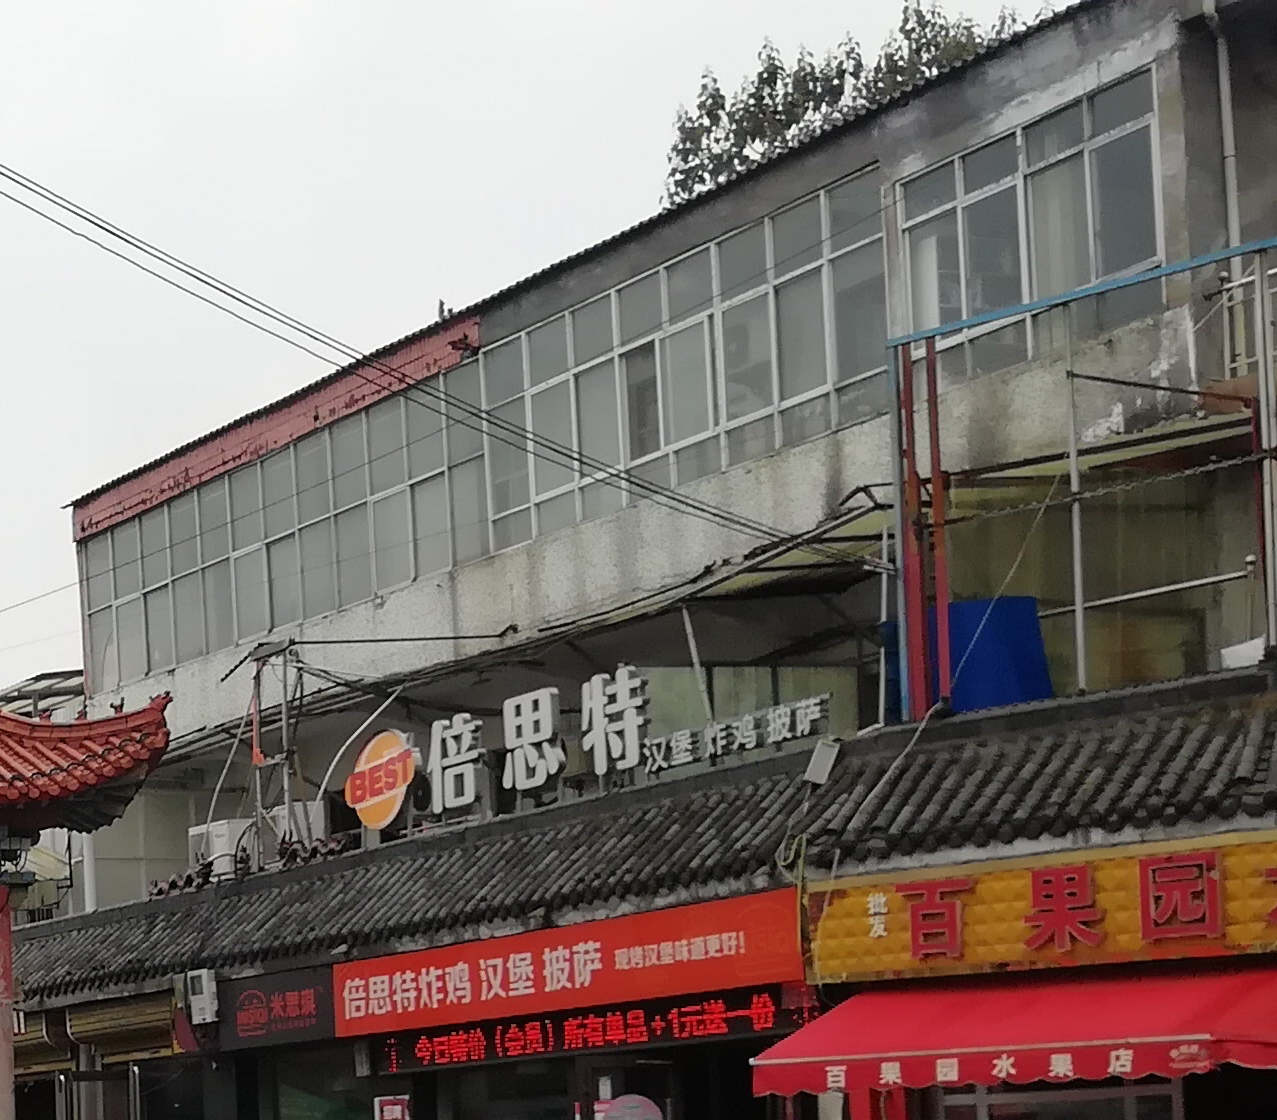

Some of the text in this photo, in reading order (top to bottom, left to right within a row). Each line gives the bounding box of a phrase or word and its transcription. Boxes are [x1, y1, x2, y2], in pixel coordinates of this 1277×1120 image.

[426, 664, 647, 814] 倍思特
[643, 698, 825, 774] 汉堡 炸鸡 披萨
[348, 748, 413, 806] BEST
[866, 892, 888, 938] 批发
[895, 850, 1277, 959] 百果园
[342, 964, 471, 1020] 倍思特炸鸡
[479, 952, 535, 1001] 汉堡
[543, 940, 603, 992] 披萨
[825, 1047, 1134, 1090] 百果园水果店
